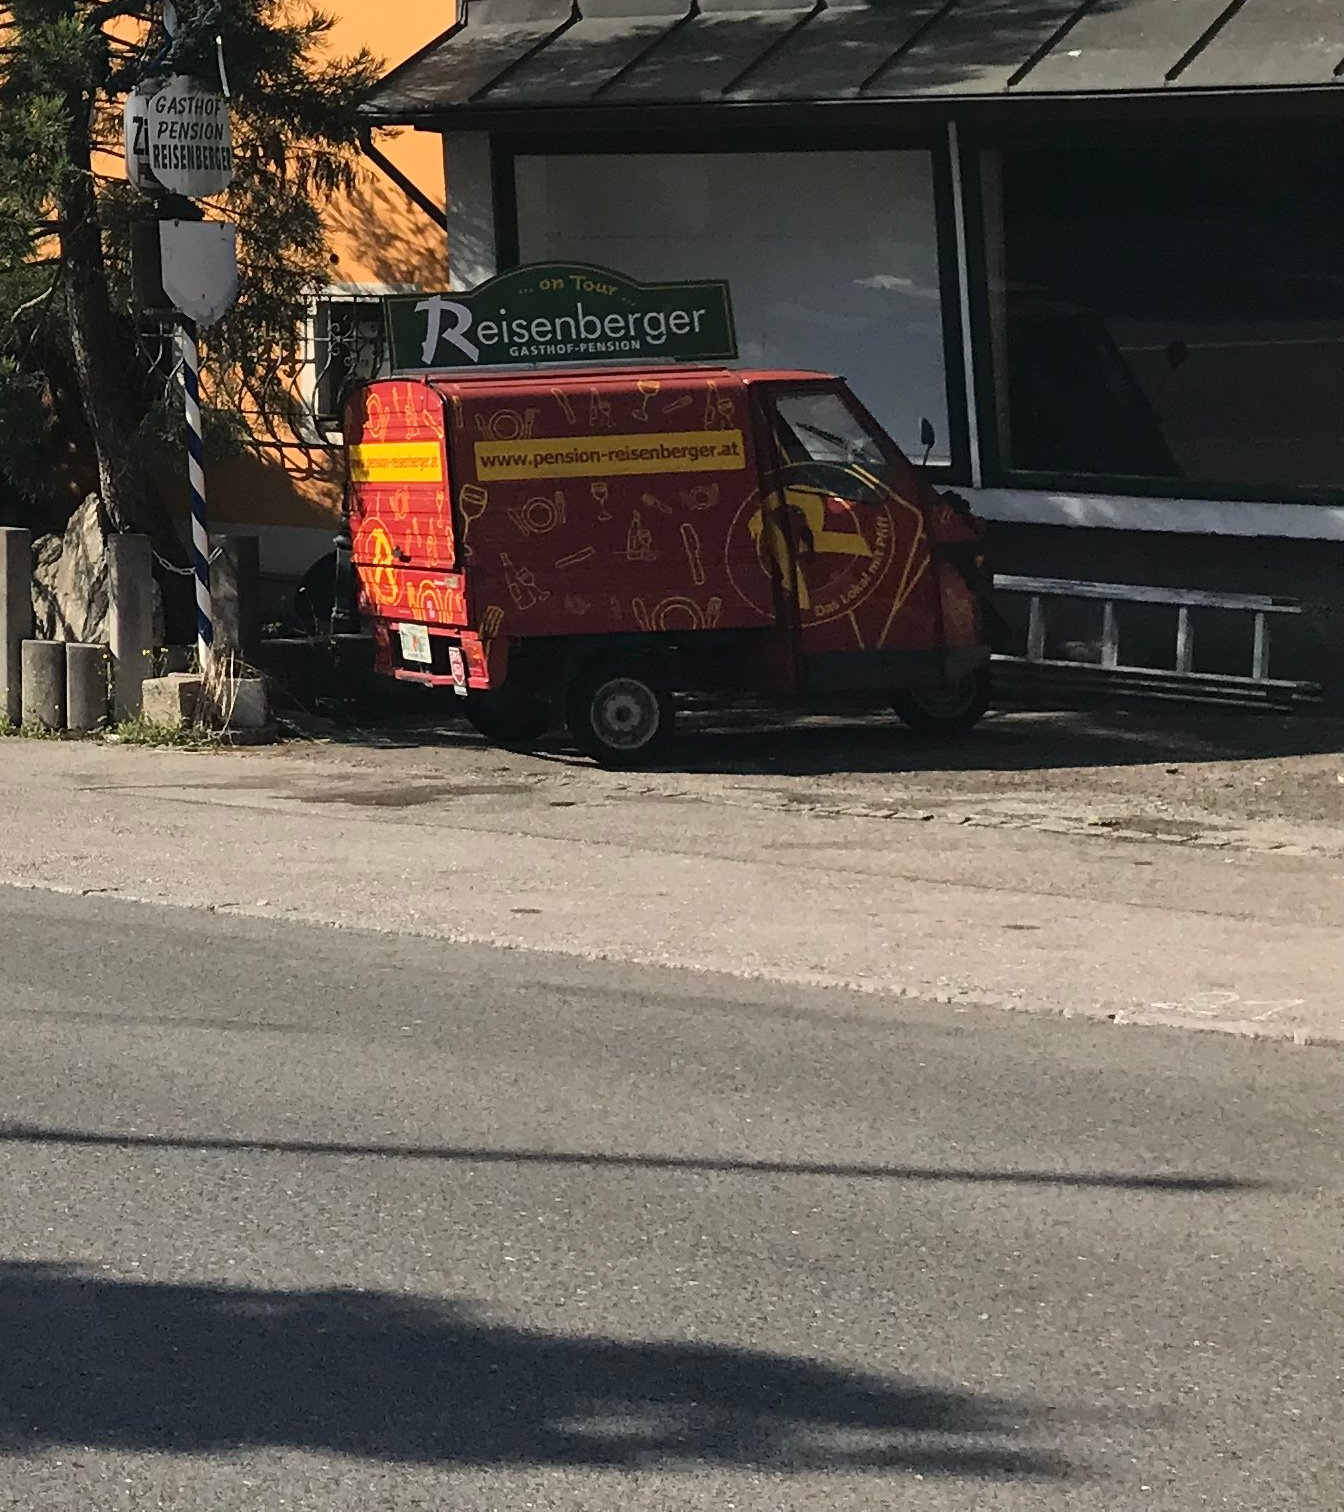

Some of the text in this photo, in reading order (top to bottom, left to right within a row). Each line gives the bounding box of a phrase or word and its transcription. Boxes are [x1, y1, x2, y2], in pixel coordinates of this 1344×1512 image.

[155, 95, 222, 117] GASTHOF
[157, 120, 224, 141] PENSION
[152, 143, 231, 171] REISENBERGER
[569, 274, 618, 296] Tour
[413, 294, 706, 366] Reisenberger
[509, 340, 641, 357] GASTHOF-PENSION
[479, 441, 741, 470] www.pension-reisenberger.at
[814, 601, 841, 617] Das
[840, 571, 872, 604] Lokal
